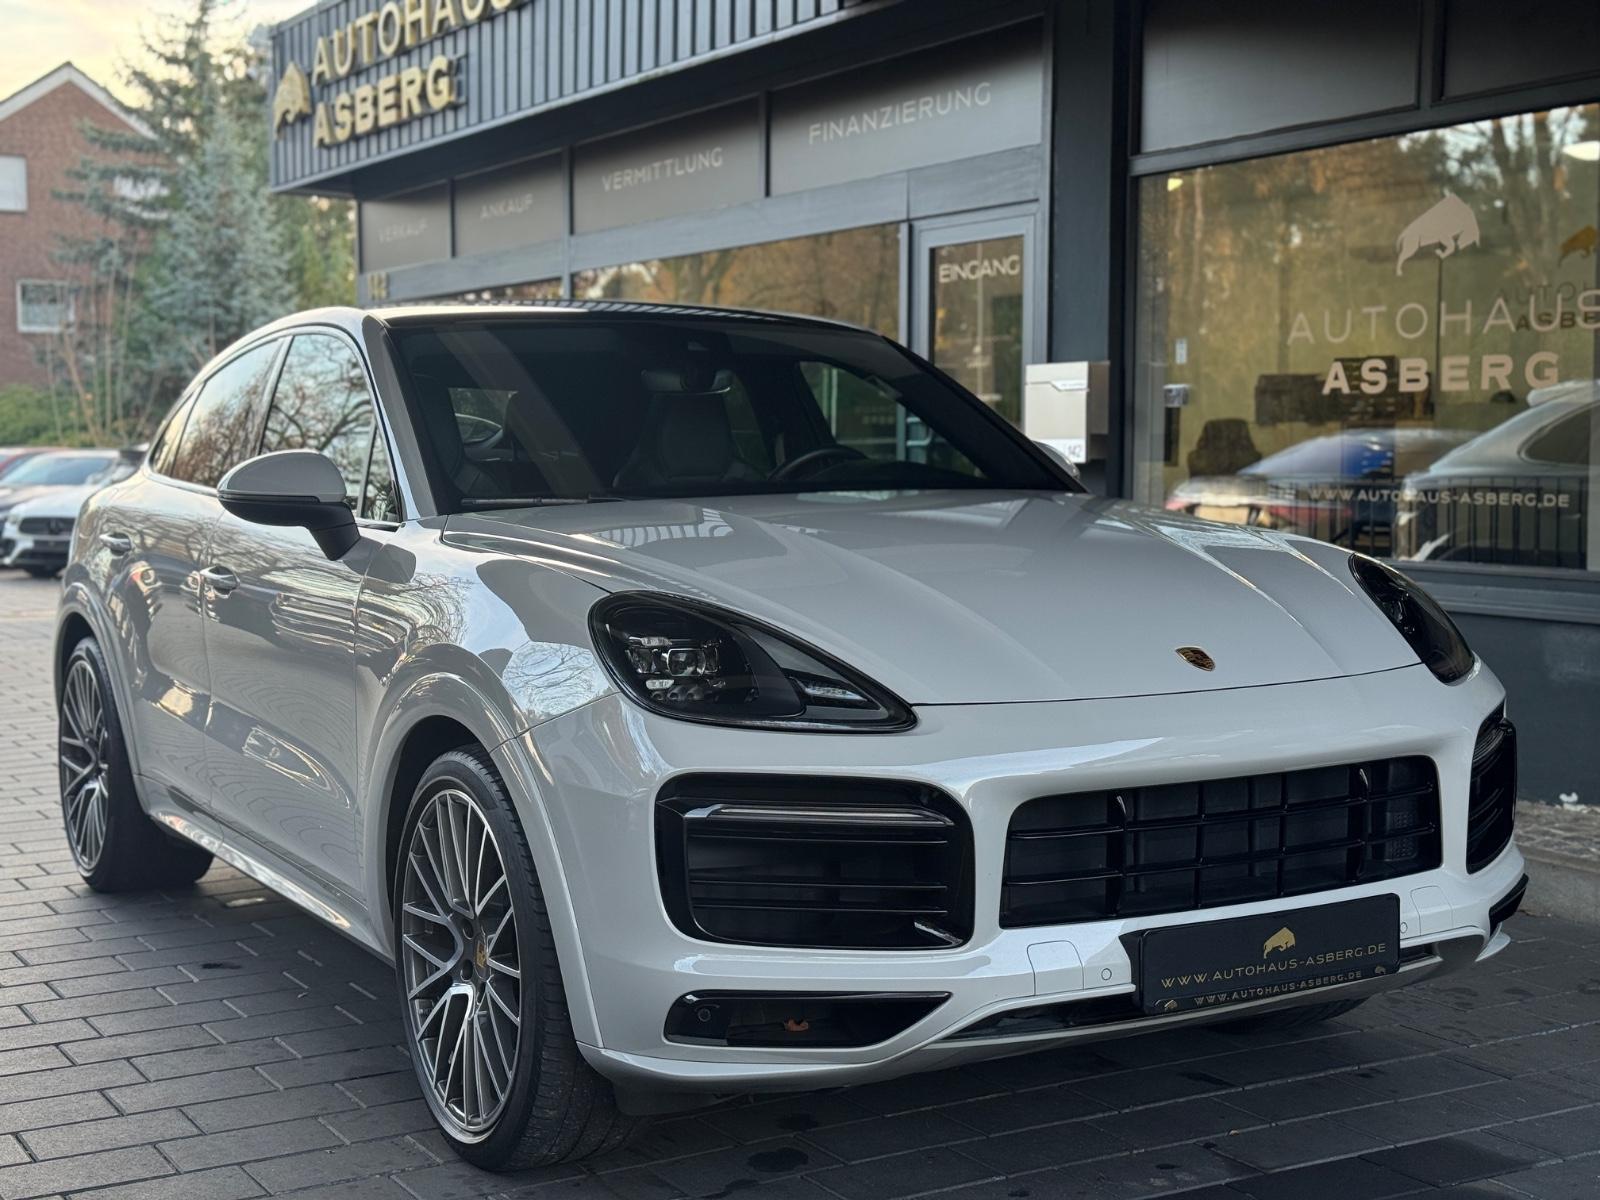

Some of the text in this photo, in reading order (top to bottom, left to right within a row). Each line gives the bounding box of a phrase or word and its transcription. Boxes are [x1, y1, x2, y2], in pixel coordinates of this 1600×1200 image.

[311, 0, 514, 87] AUTOHA
[313, 55, 457, 148] ASBERG
[808, 82, 993, 145] FINANZIERUNG
[602, 147, 724, 192] VERMITTLUNG
[938, 255, 1021, 284] EINGANG
[1287, 289, 1600, 346] AUTOHAUS
[1321, 351, 1560, 396] ASBERG
[1308, 487, 1571, 508] WWW.AUTOAUS-ASBERG.DE
[1161, 943, 1387, 989] WWW.AUTOHAUS-ASBERG.DE
